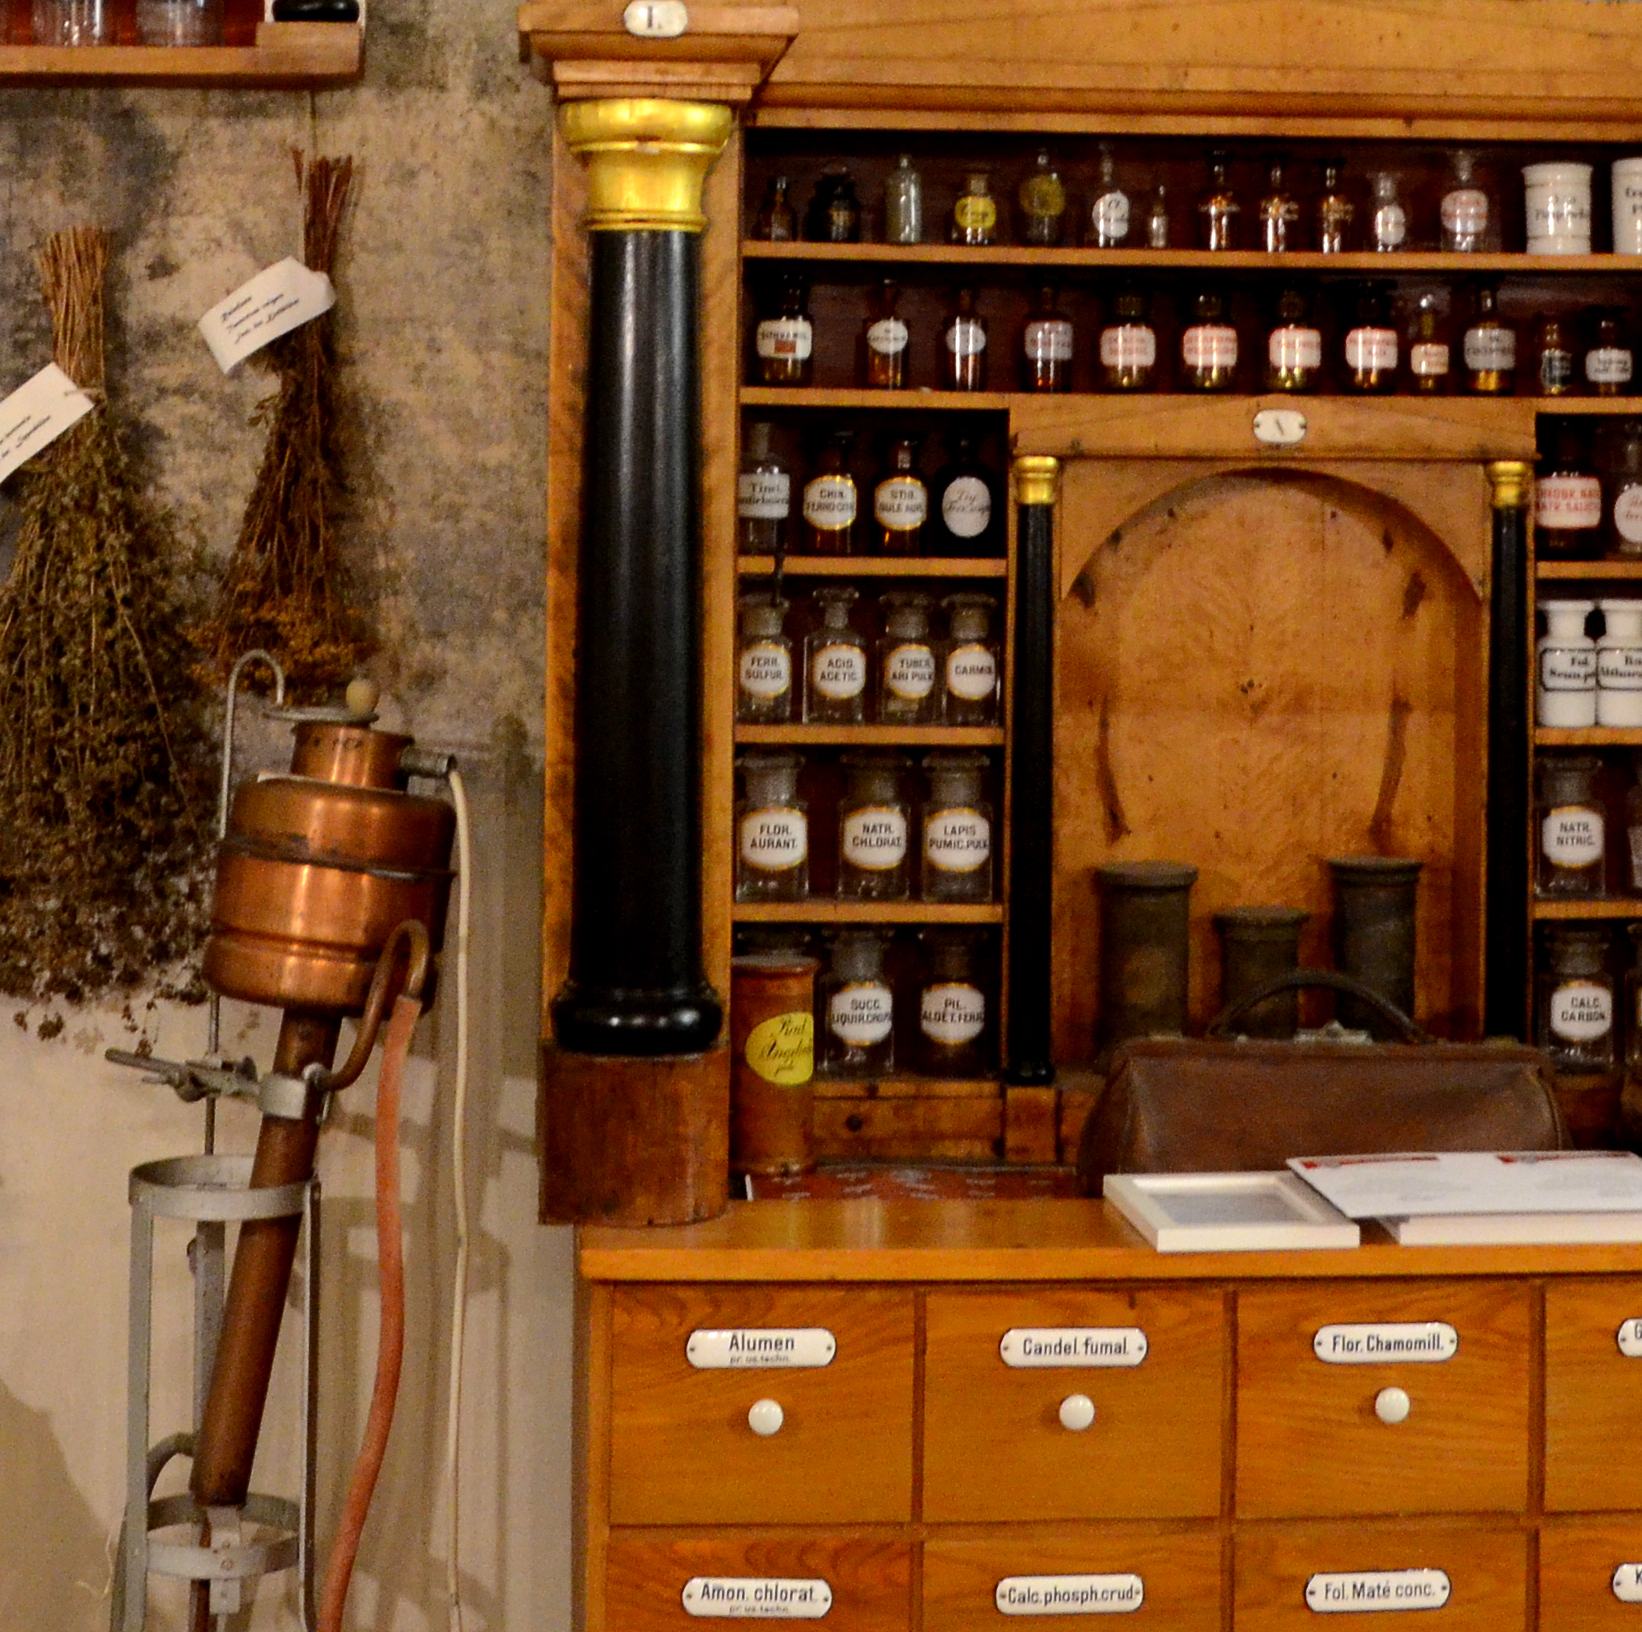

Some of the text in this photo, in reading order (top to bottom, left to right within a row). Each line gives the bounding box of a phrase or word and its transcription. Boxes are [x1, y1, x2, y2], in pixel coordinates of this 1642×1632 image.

[759, 823, 793, 836] FLOR.
[861, 822, 894, 835] NATR.
[943, 825, 976, 837] LAPIS
[728, 1333, 796, 1353] Alumen
[1022, 1336, 1130, 1357] Candel. fumal.
[1331, 1331, 1445, 1354] Flor. Chamomill.
[699, 1581, 819, 1603] Amon. chlorat.
[1323, 1574, 1436, 1601] Fol. Maté conc.
